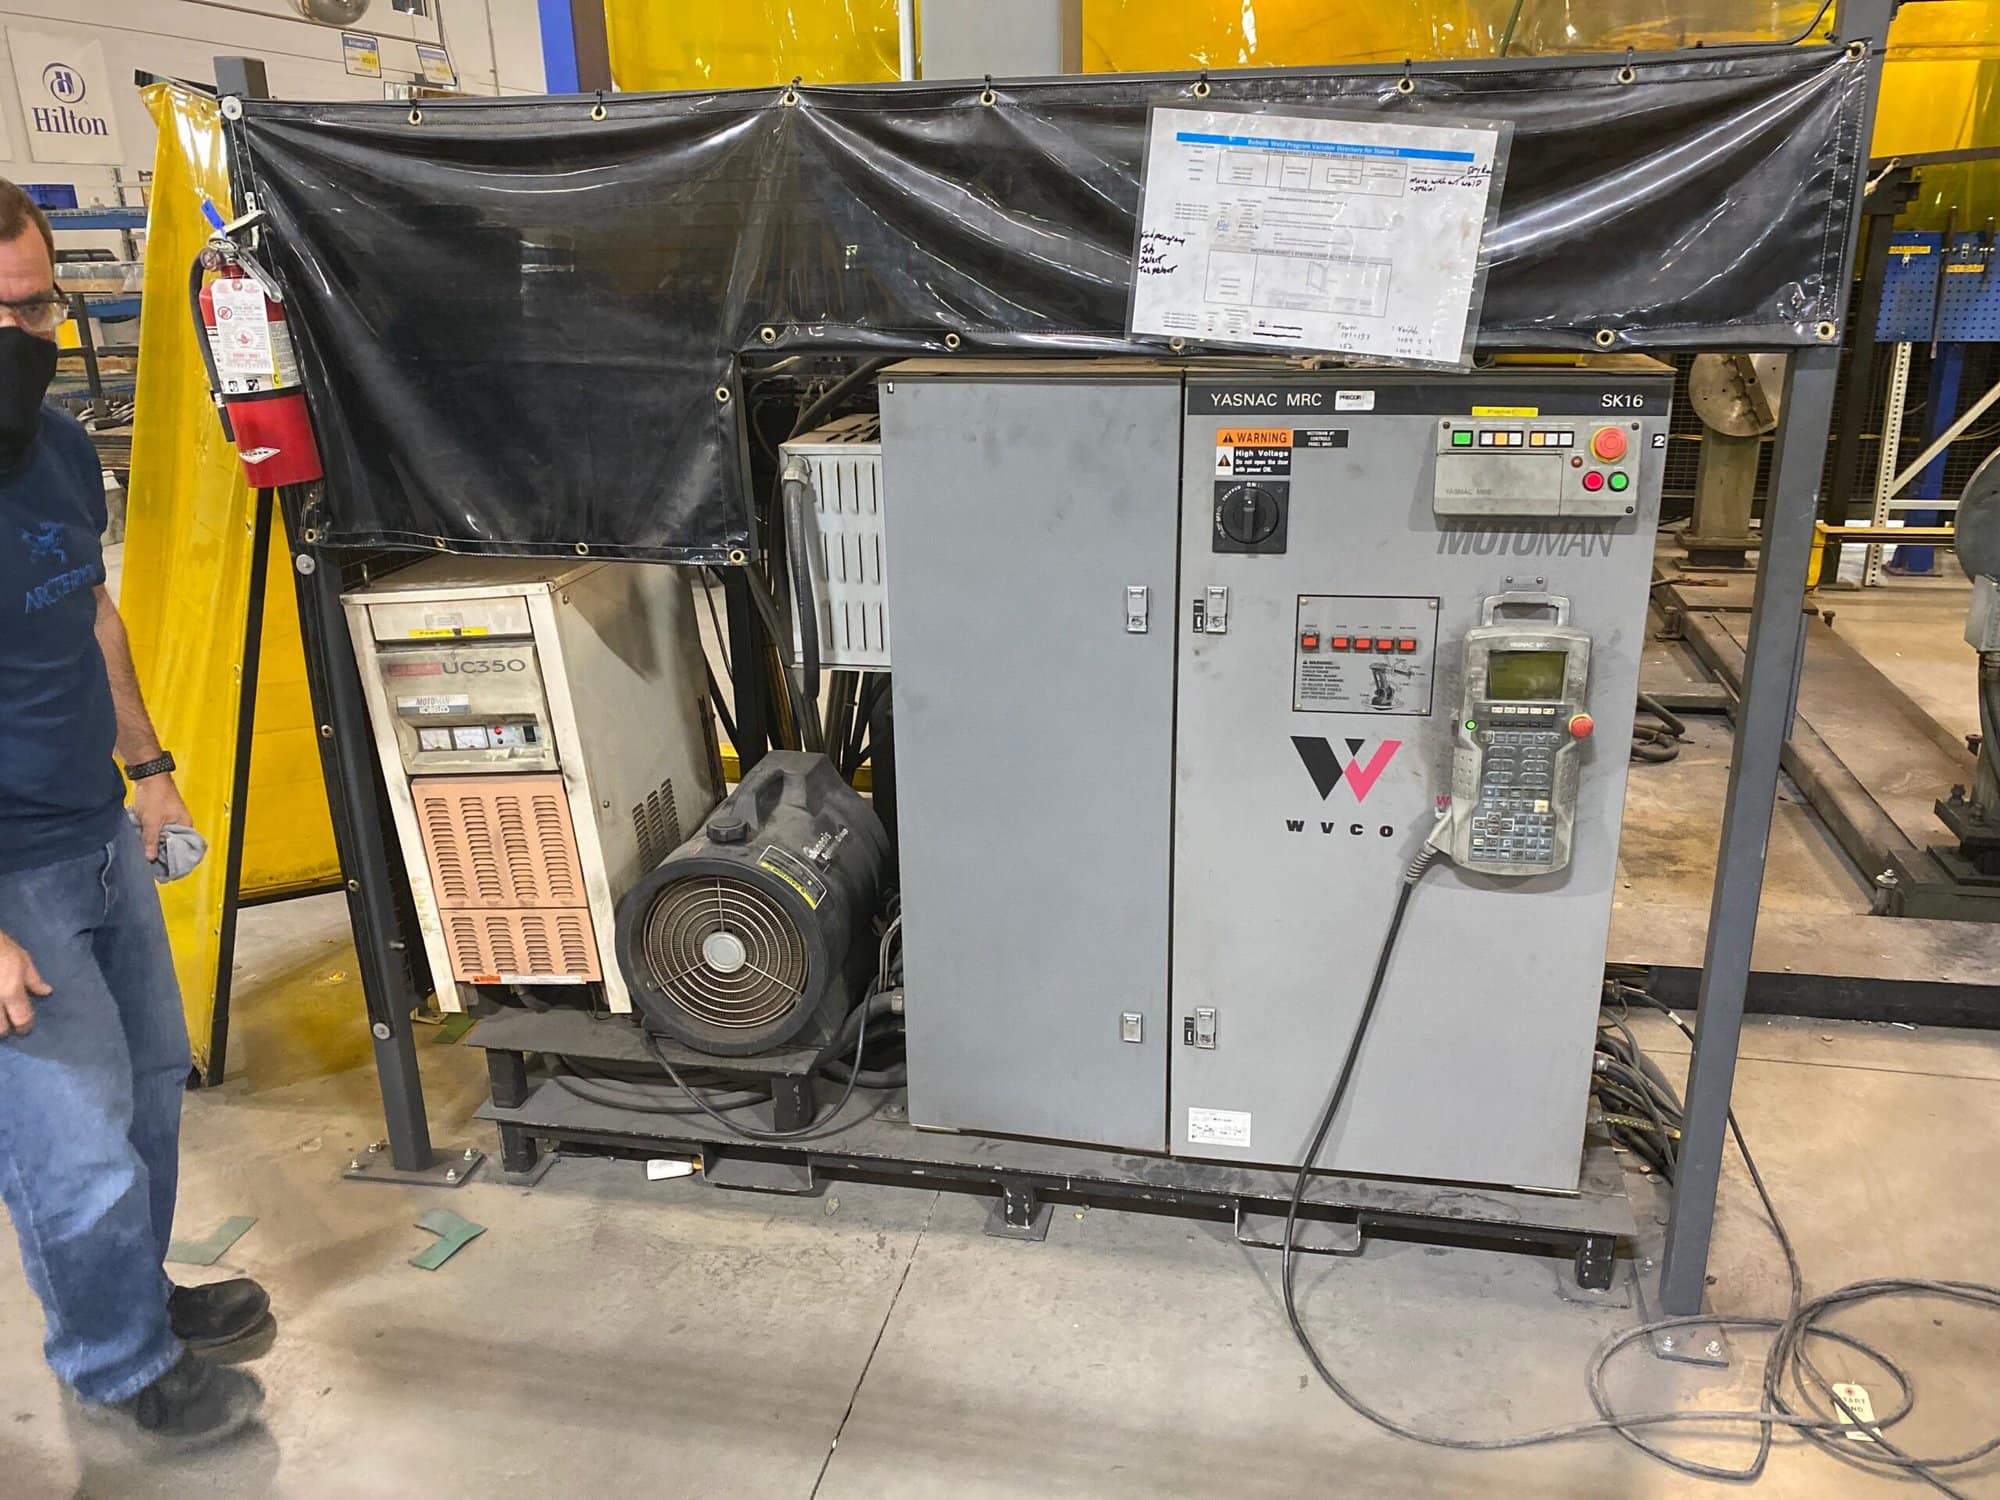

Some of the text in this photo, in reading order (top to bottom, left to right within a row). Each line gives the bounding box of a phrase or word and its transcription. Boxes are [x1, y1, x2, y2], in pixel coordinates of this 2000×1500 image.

[32, 106, 109, 136] Hilton
[1211, 393, 1322, 407] YASNAC MRC
[1601, 394, 1644, 408] SK16
[1237, 432, 1287, 443] WARNING
[1653, 435, 1665, 447] 2
[1235, 449, 1289, 458] High Voltage
[441, 659, 526, 675] UC350
